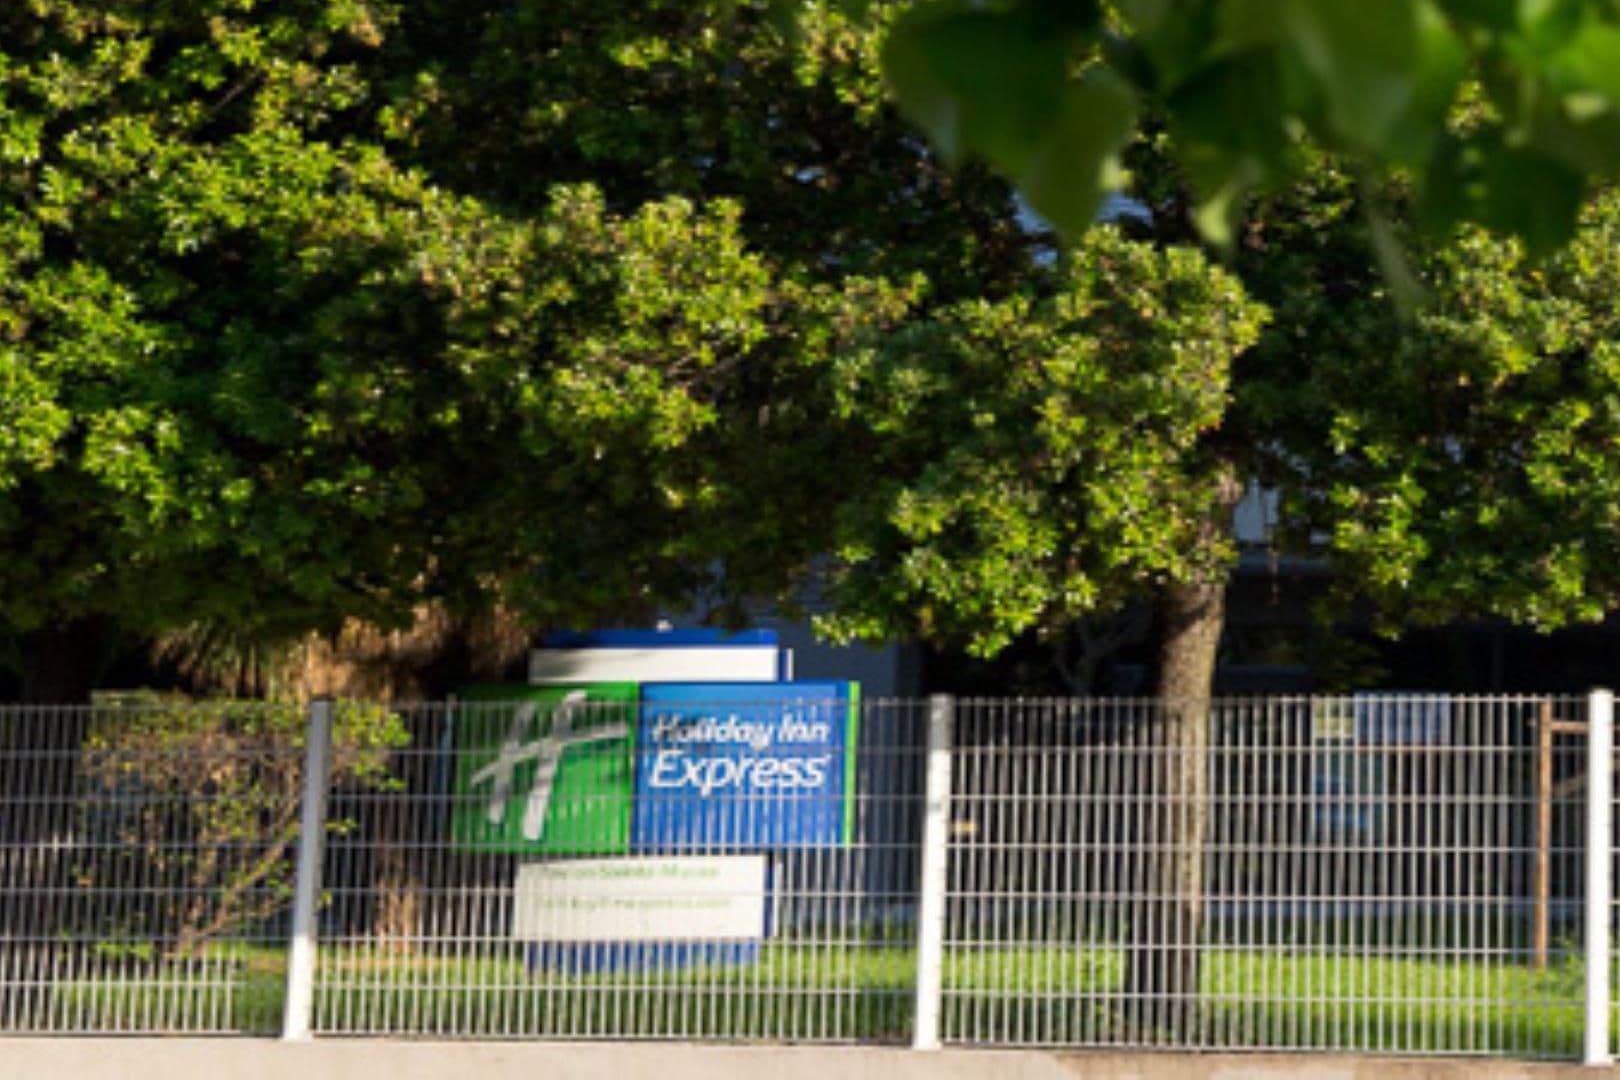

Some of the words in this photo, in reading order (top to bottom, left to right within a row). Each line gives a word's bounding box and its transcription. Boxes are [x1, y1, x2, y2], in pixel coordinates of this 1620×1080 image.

[652, 713, 773, 751] Holiday
[777, 712, 829, 743] Inn
[650, 748, 830, 797] Express
